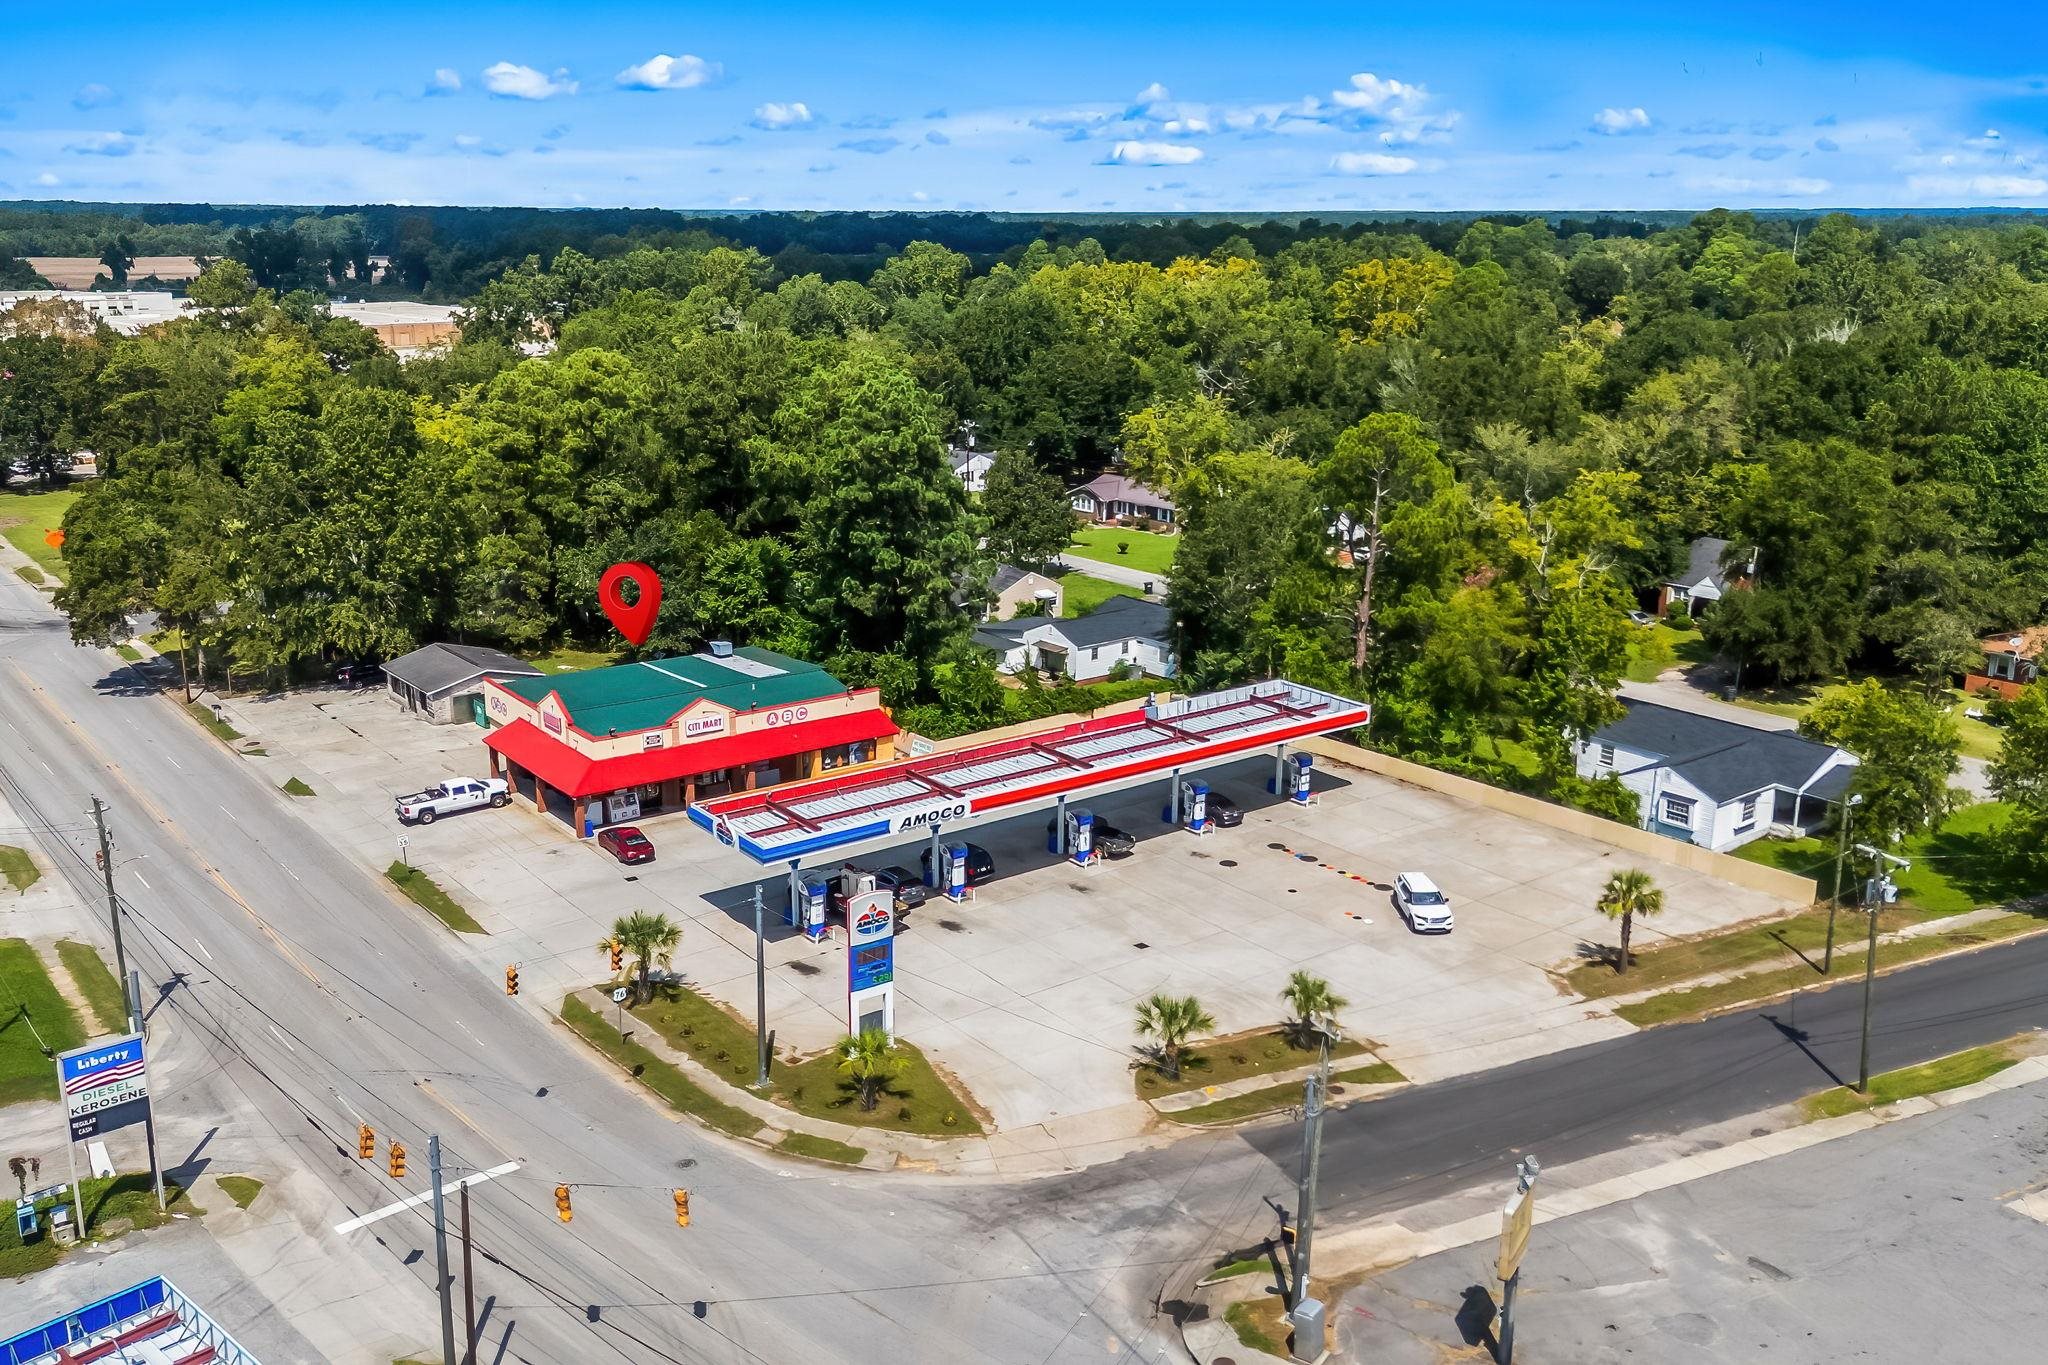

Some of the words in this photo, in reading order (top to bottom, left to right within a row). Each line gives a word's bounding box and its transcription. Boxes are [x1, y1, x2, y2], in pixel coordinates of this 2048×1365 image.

[688, 722, 700, 731] CITI
[702, 719, 722, 729] MART
[899, 805, 965, 829] AMOCO
[856, 916, 890, 929] AMOCO
[615, 990, 625, 999] 76
[77, 1050, 128, 1070] Liberty
[83, 1082, 134, 1102] DIESEL
[71, 1088, 147, 1116] KEROSENE
[72, 1117, 97, 1129] REGULAR
[78, 1126, 93, 1135] CASH
